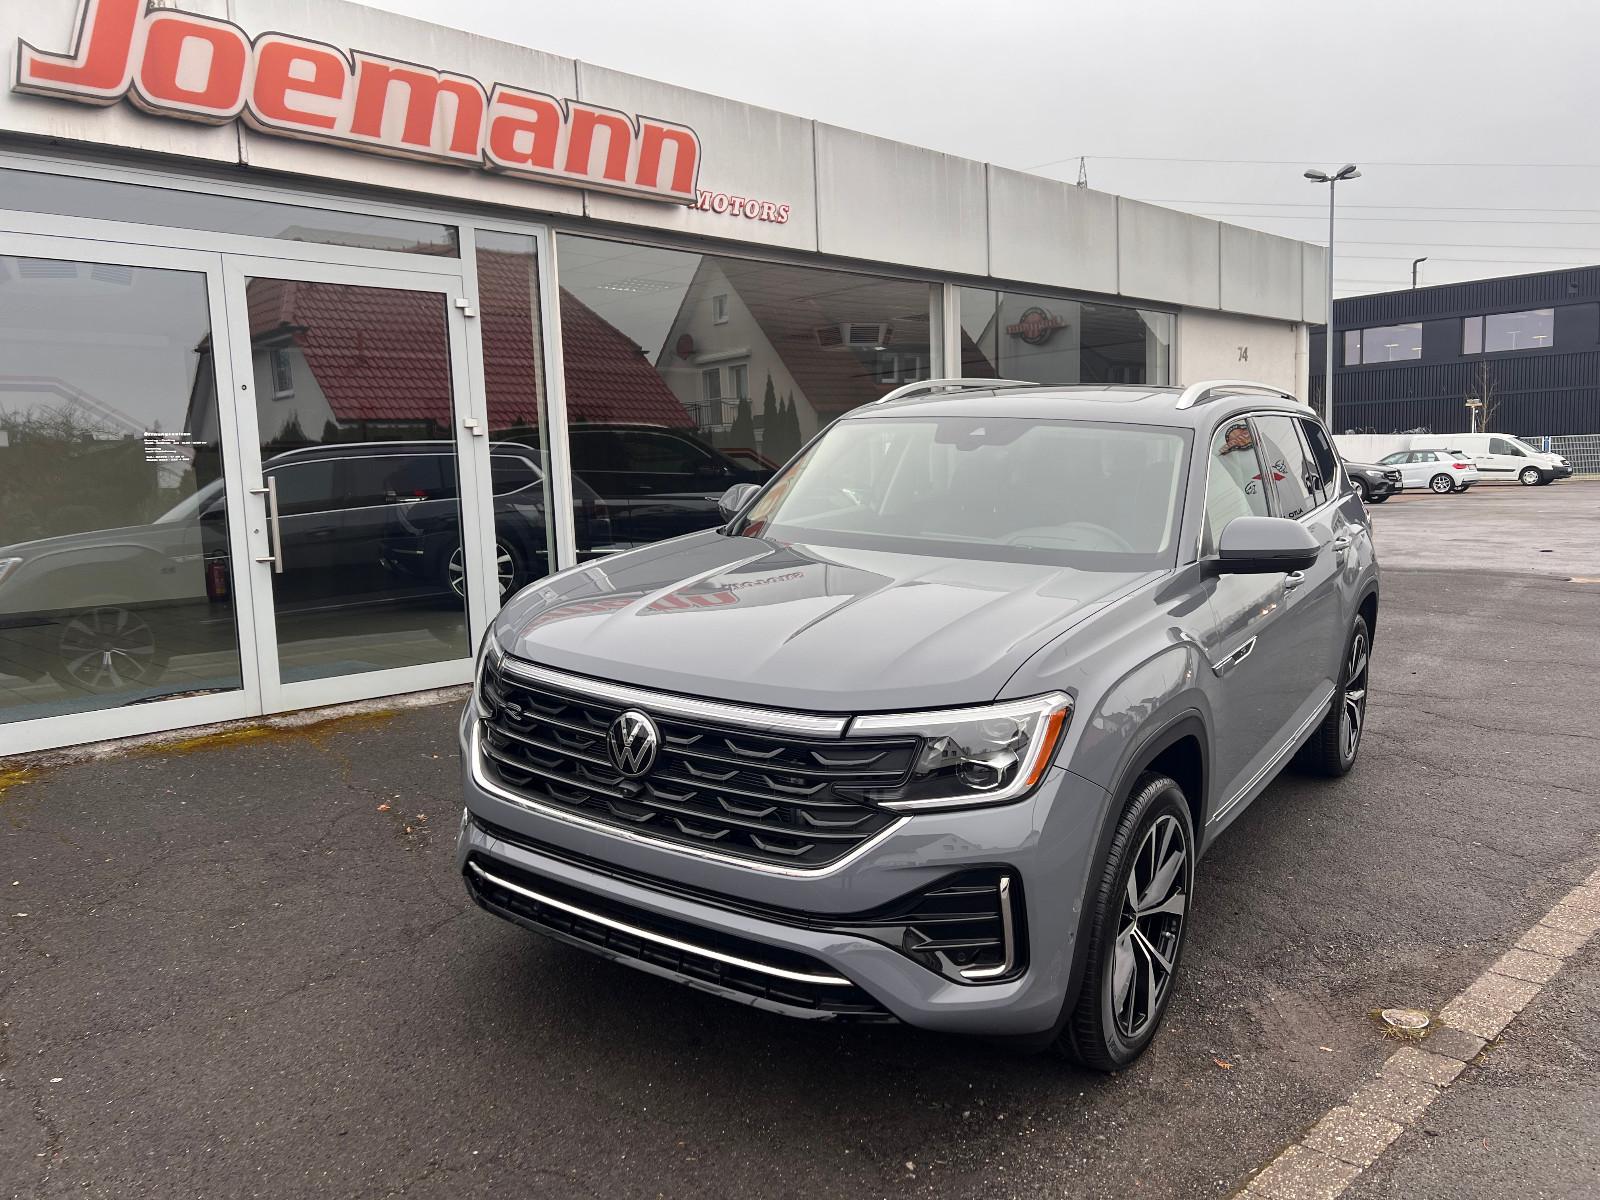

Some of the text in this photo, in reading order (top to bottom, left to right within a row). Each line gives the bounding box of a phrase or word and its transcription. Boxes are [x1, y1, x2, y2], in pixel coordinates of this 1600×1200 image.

[29, 0, 697, 196] Joemann
[688, 189, 790, 224] MOTORS
[1237, 346, 1249, 362] 74
